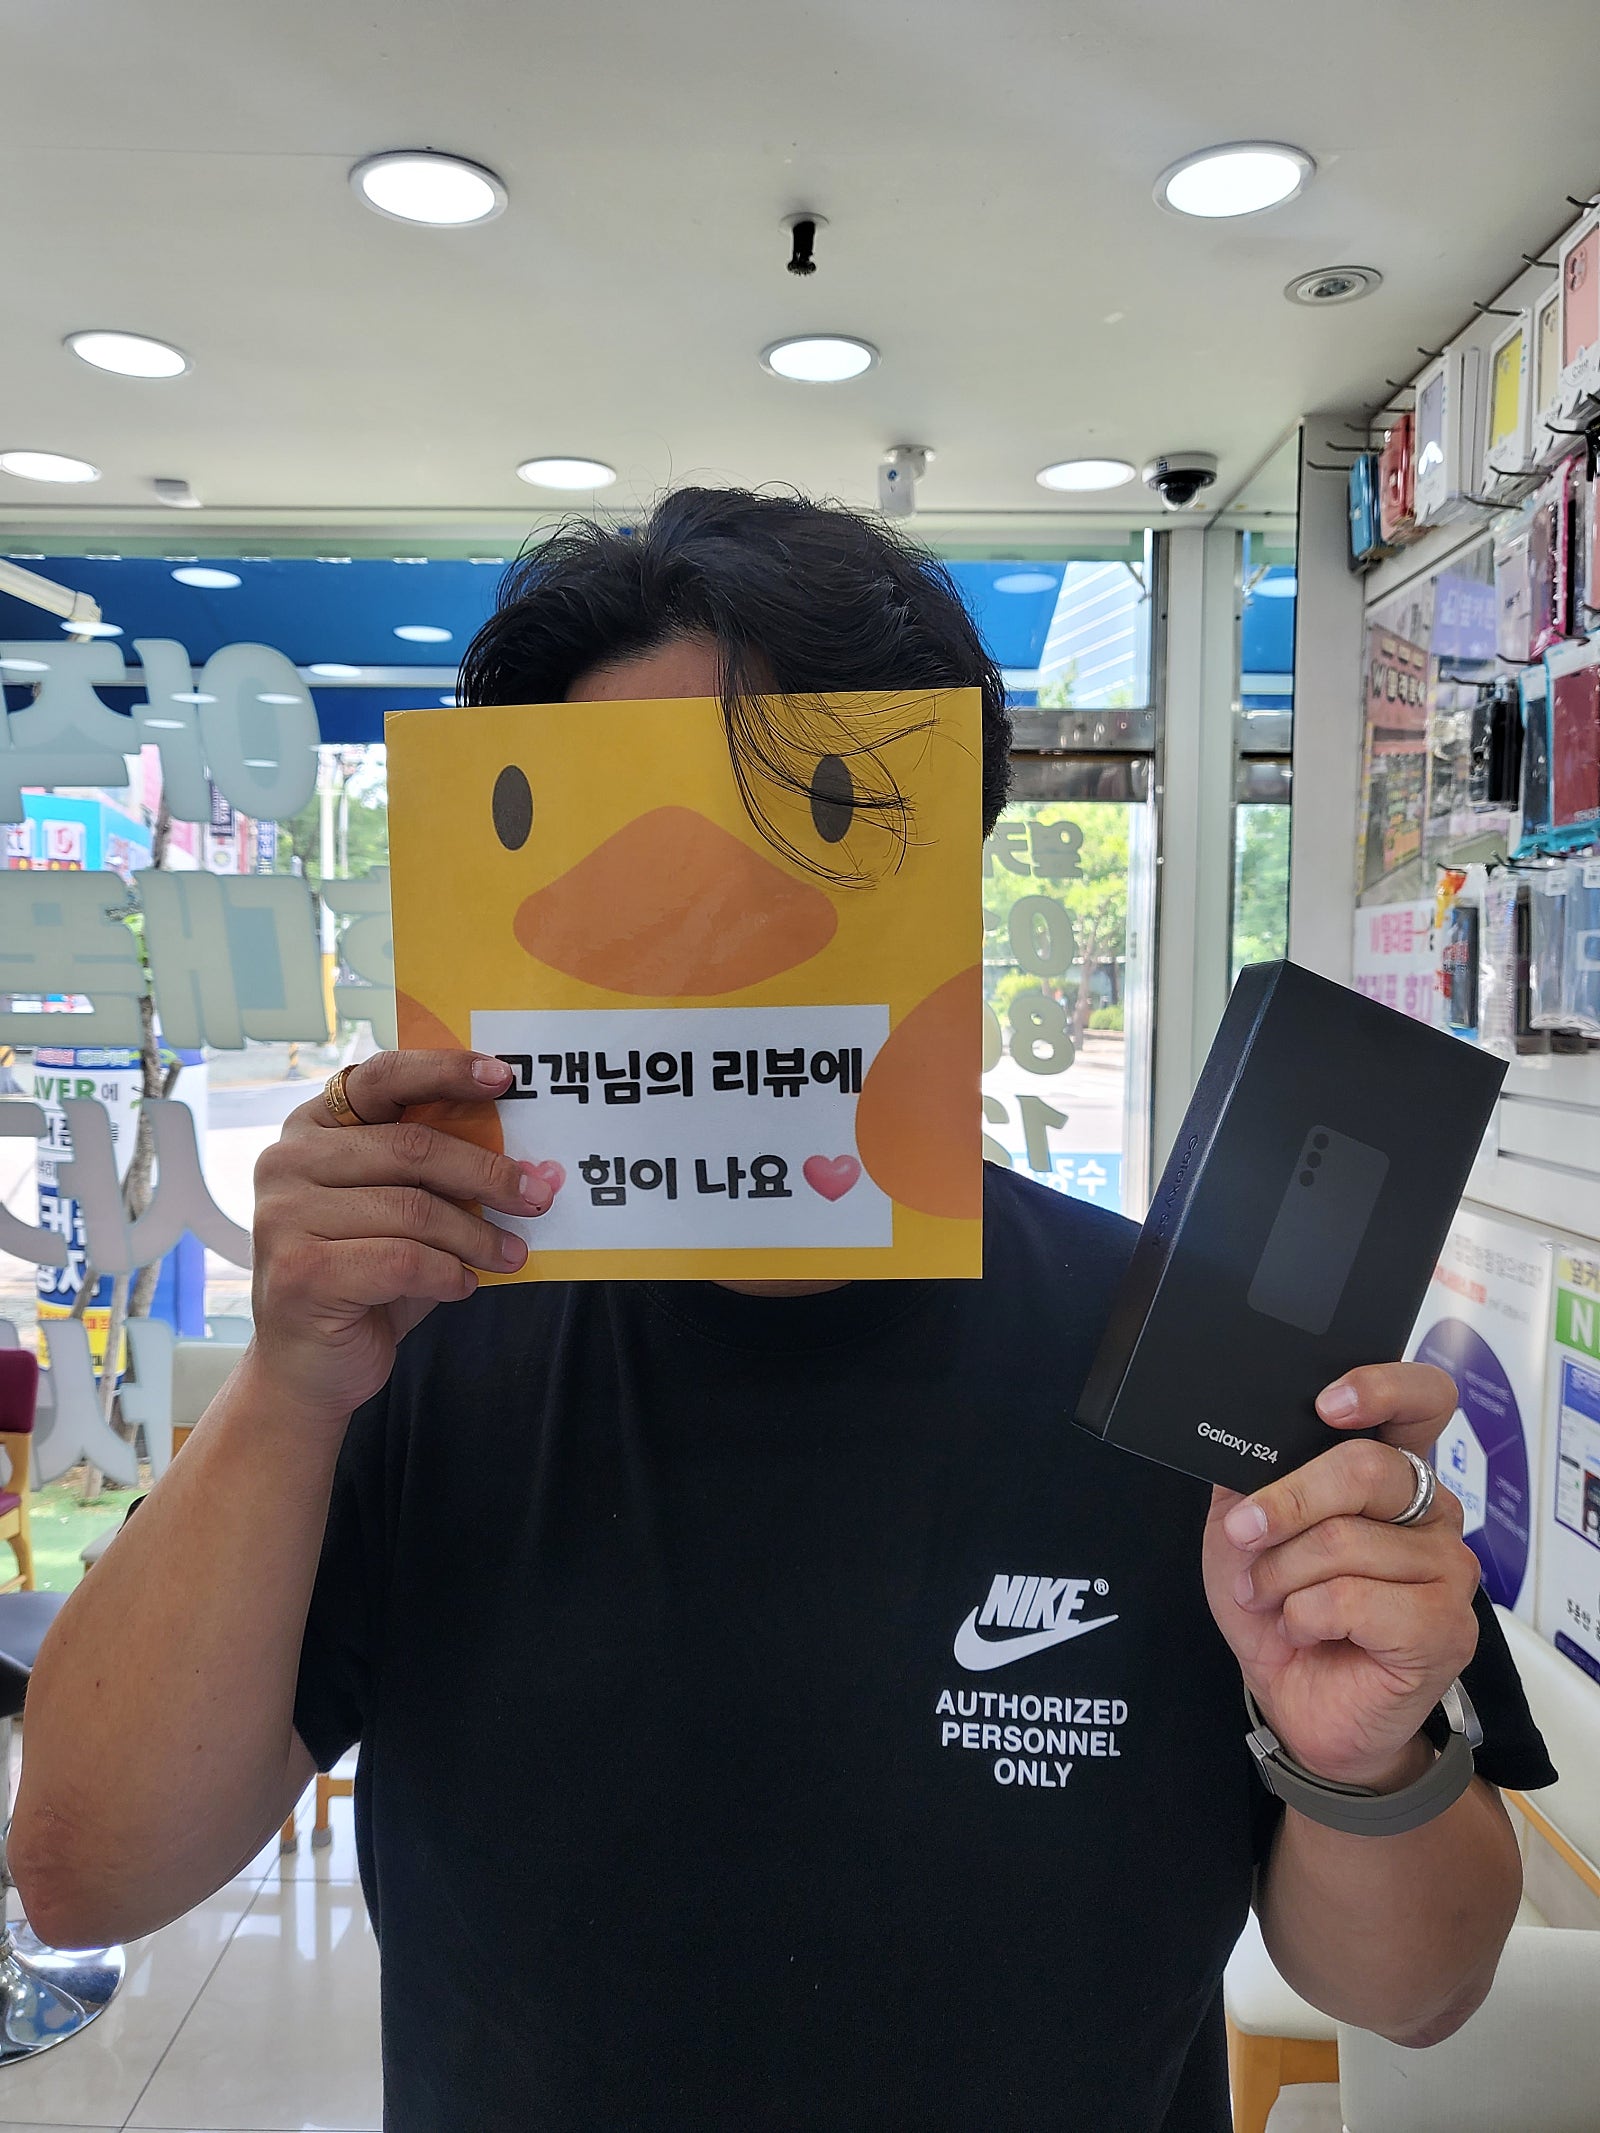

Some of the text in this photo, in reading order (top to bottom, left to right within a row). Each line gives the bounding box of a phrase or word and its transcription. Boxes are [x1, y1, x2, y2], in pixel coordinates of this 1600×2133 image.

[494, 1047, 863, 1104] 고객님의 리뷰에
[578, 1154, 792, 1206] 힘이 나요
[1197, 1422, 1280, 1464] Galaxy S24
[978, 1574, 1091, 1630] NIKE
[935, 1689, 1129, 1726] AUTHORIZED
[941, 1721, 1122, 1757] PERSONNEL
[993, 1757, 1074, 1788] ONLY
